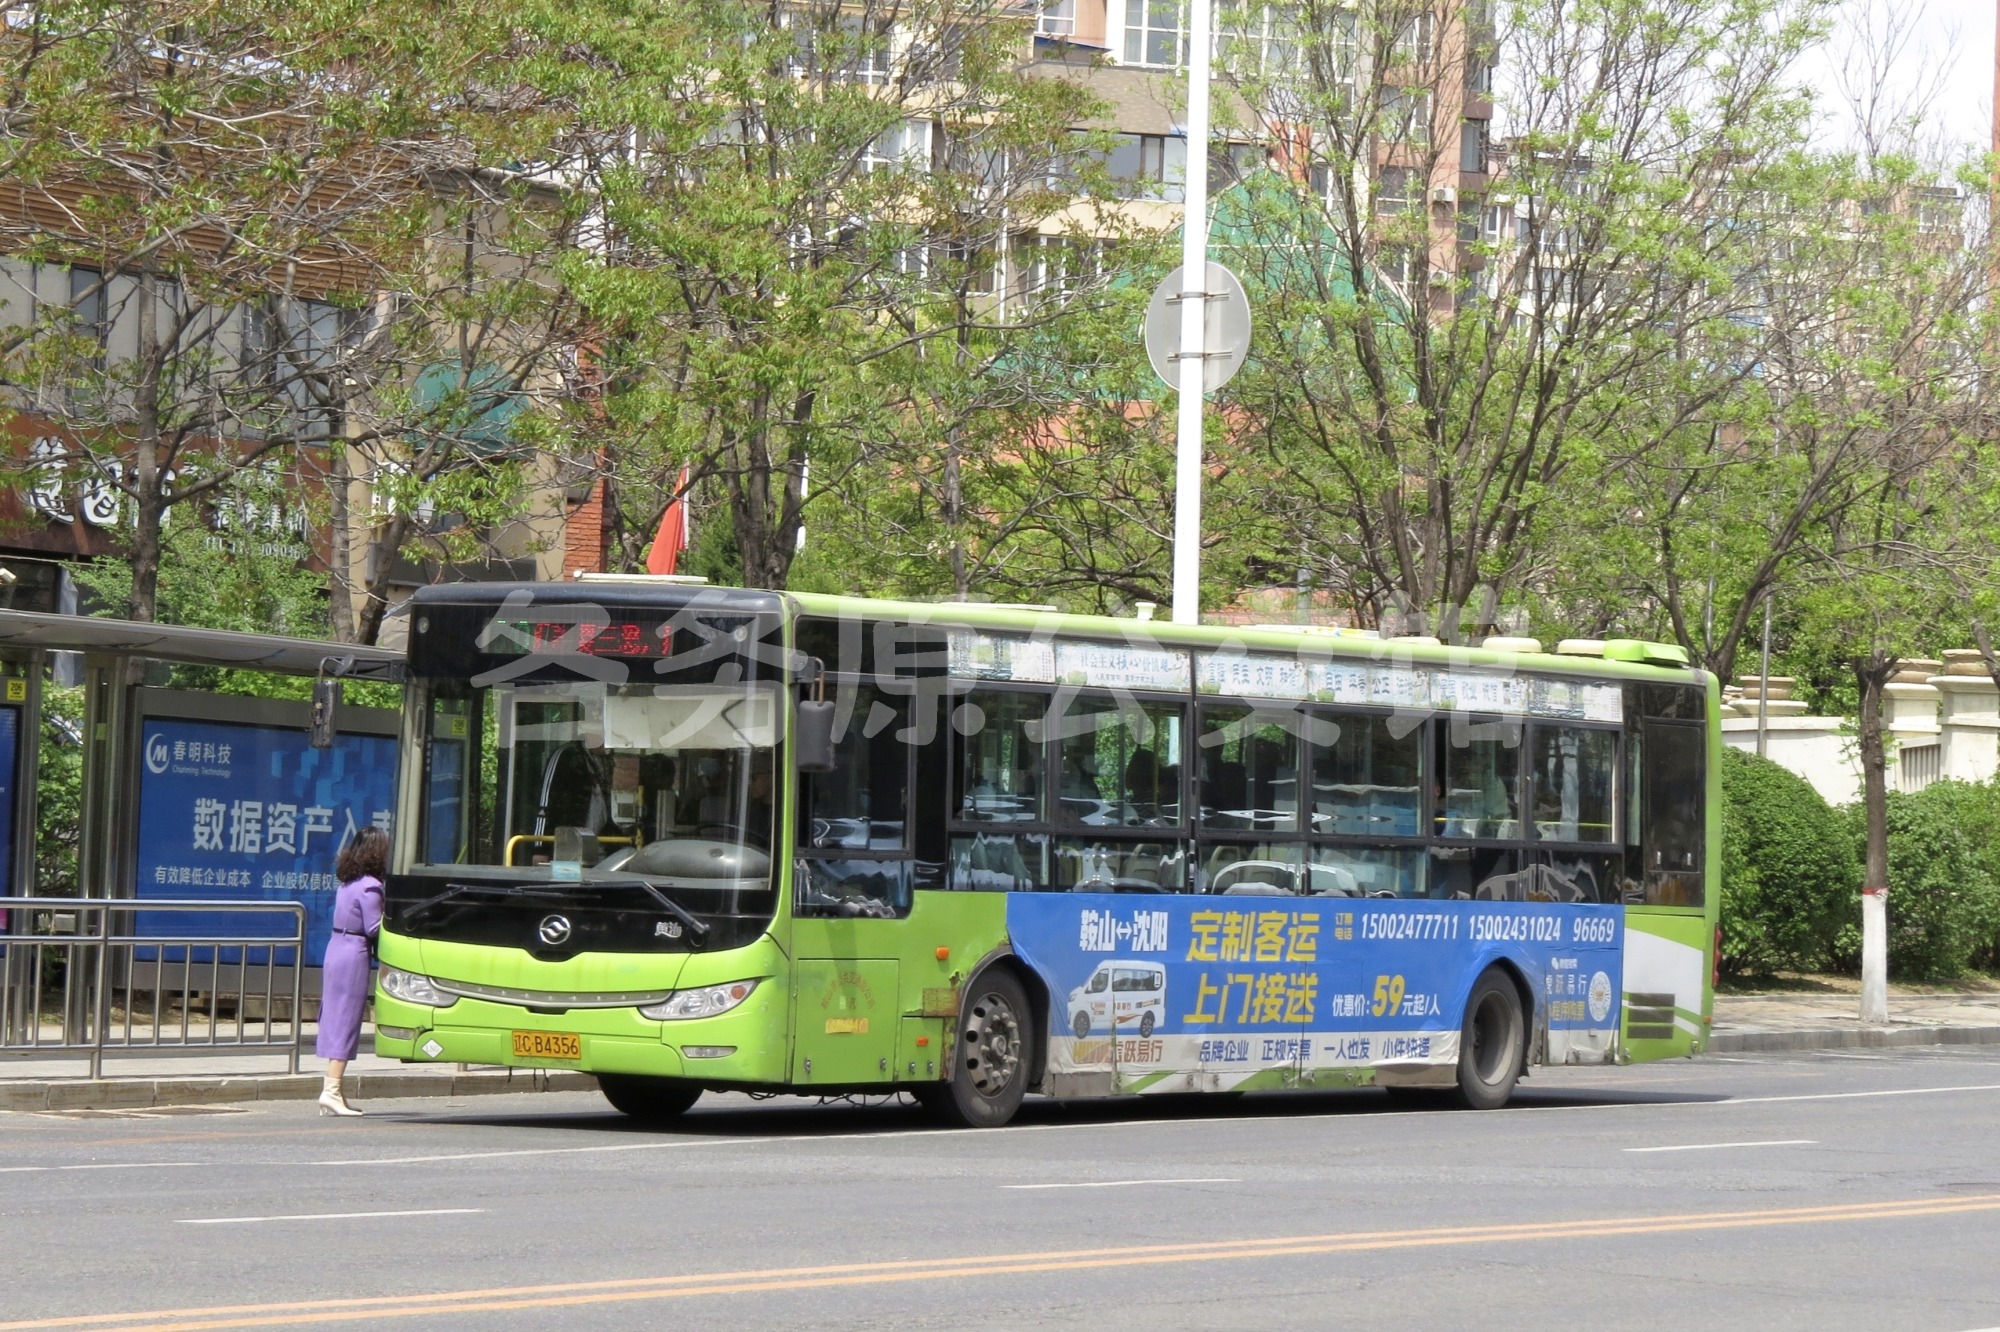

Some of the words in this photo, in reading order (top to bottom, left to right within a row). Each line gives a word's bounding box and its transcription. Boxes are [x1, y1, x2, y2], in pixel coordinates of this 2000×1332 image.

[173, 740, 232, 764] 春明科技
[154, 865, 251, 888] 有效降低企业成本
[654, 921, 683, 940] 黄海
[1079, 909, 1116, 952] 鞍山
[1132, 910, 1169, 952] 沈阳
[1186, 909, 1320, 963] 定制客运
[1361, 912, 1459, 940] 15002477711
[1469, 914, 1562, 942] 15002431024
[1573, 916, 1615, 943] 96669
[1183, 973, 1319, 1025] 上门接送
[1200, 1040, 1249, 1063] 品牌企业
[1261, 1039, 1312, 1062] 正规发票
[1324, 1038, 1370, 1060] 一人也发
[1382, 1037, 1431, 1059] 小件快递
